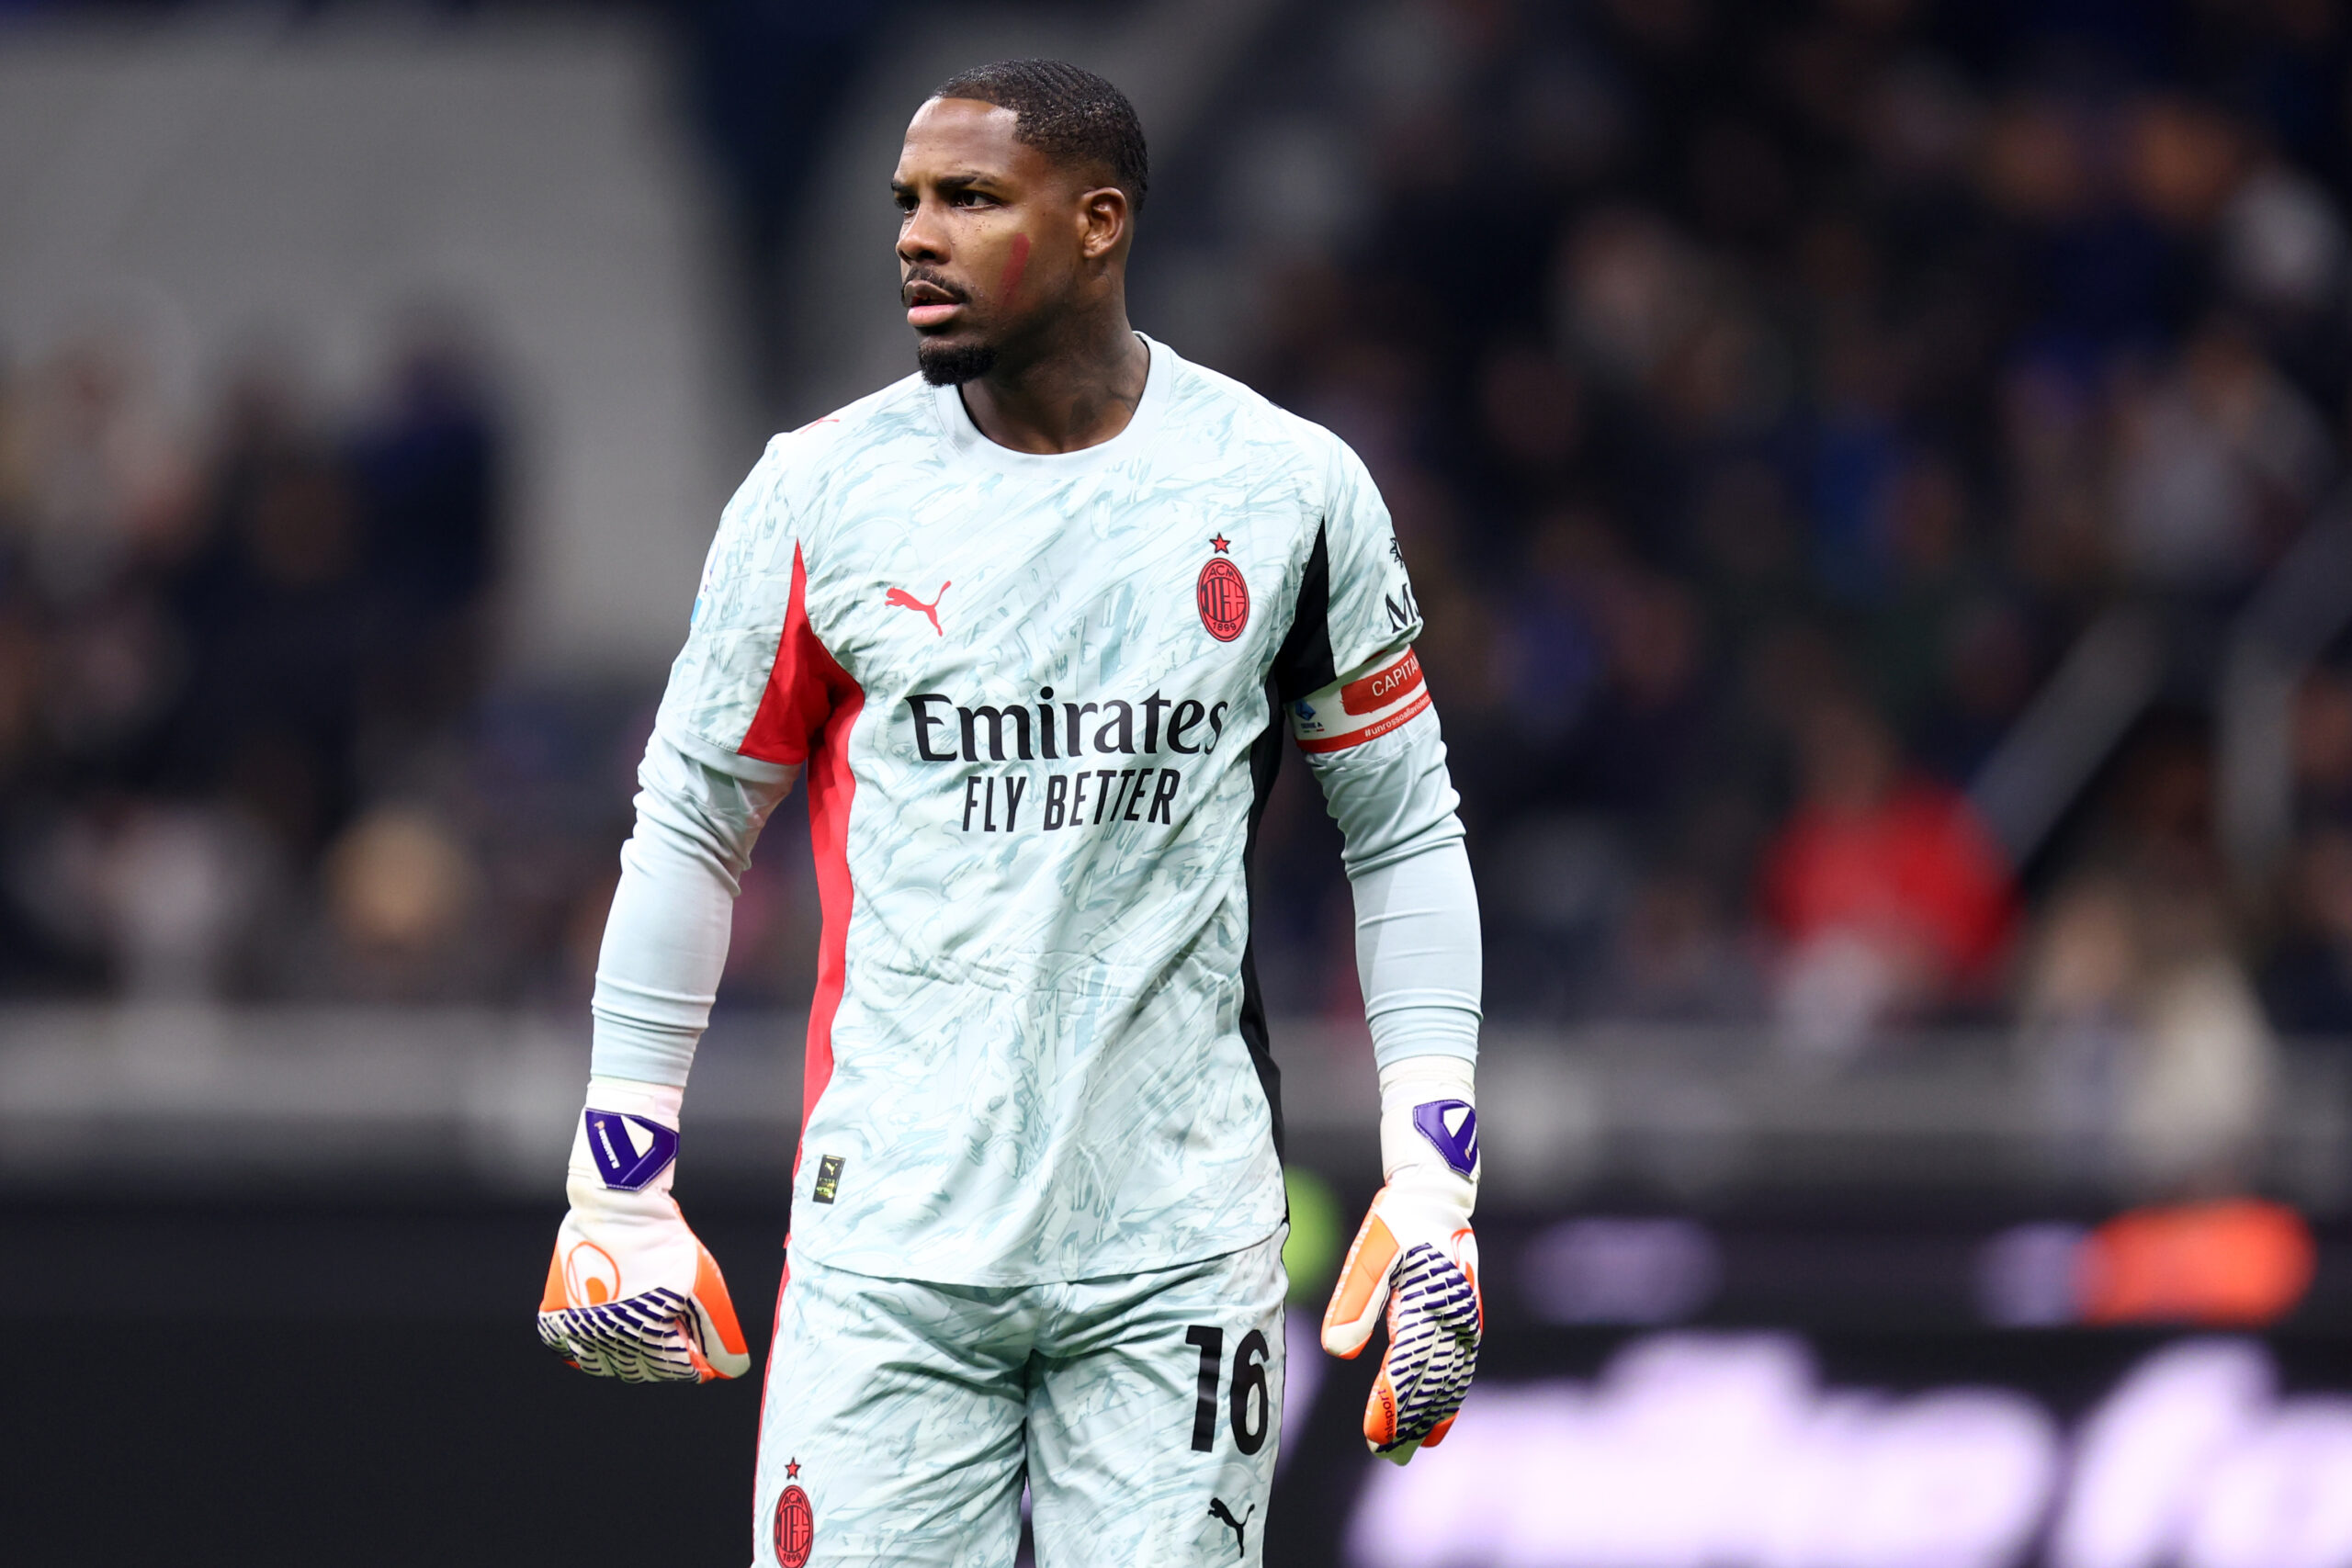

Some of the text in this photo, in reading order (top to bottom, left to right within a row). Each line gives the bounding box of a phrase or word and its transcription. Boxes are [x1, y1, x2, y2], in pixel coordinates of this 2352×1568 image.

[1207, 565, 1236, 581] ACM
[1213, 622, 1237, 632] 1899
[904, 685, 1228, 761] Emirates
[962, 768, 1182, 833] FLY BETTER
[1185, 1325, 1270, 1456] 16
[783, 1552, 802, 1562] 1899
